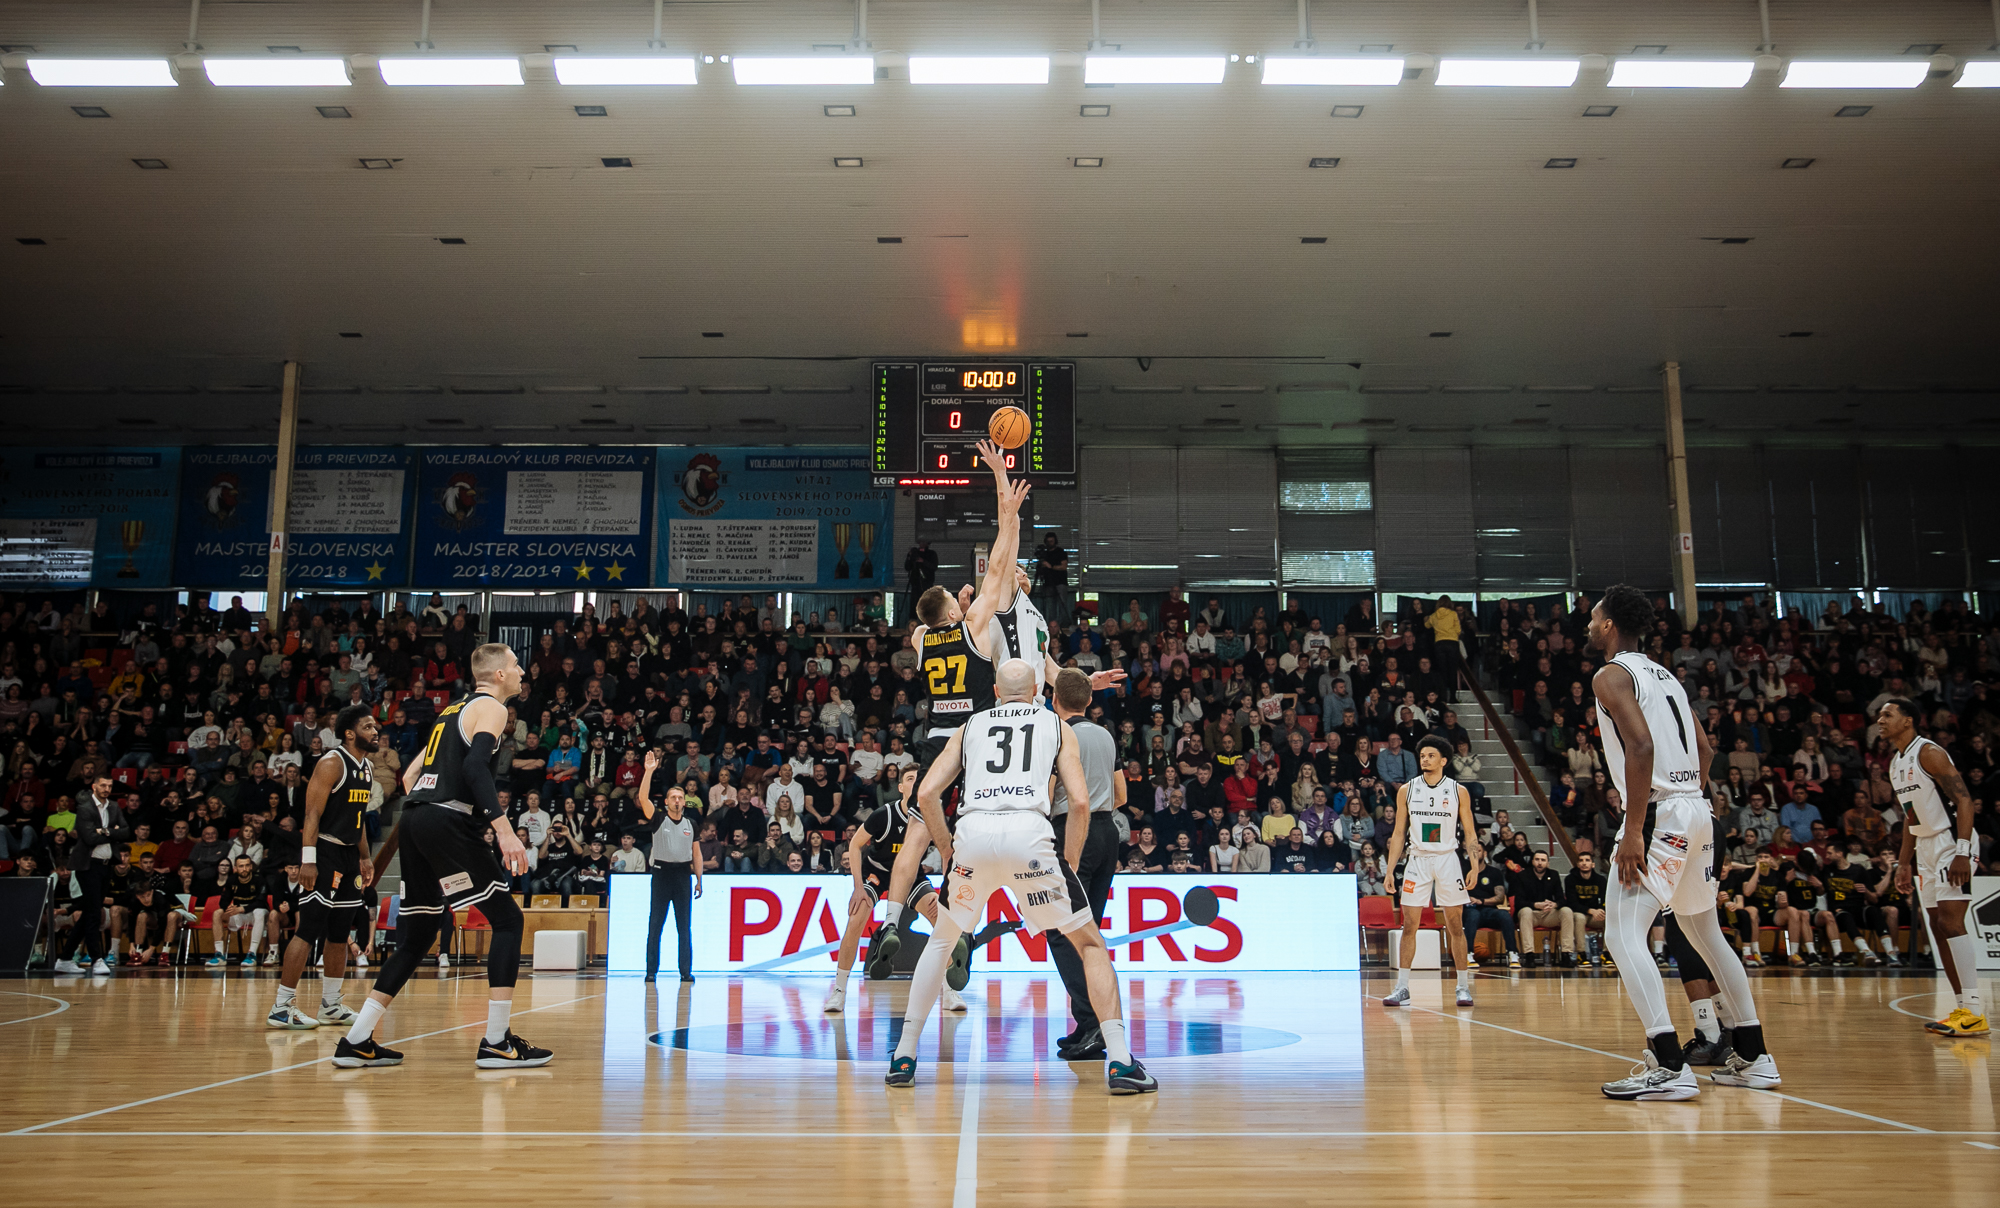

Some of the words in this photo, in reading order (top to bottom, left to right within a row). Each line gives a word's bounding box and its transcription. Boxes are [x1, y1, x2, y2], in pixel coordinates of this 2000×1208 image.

[931, 397, 962, 405] DOMÁCI
[950, 411, 961, 429] 0
[190, 454, 277, 464] VOLEJBALOV
[294, 454, 322, 464] LUB
[328, 454, 397, 464] PRIEVIDZA
[426, 450, 521, 464] VOLEJBALOVÝ
[525, 454, 559, 464] KLUB
[565, 454, 635, 464] PRIEVIDZA
[750, 457, 800, 468] VOLEJBALOVÝ
[801, 459, 820, 468] KLUB
[822, 459, 848, 468] OSMOS
[850, 459, 870, 468] PRIEV
[938, 454, 948, 469] 0
[972, 455, 978, 468] 1
[1006, 454, 1015, 469] 0
[874, 477, 895, 485] LGR
[272, 535, 281, 550] A
[1683, 536, 1690, 550] C
[194, 543, 268, 556] MAJSTE
[287, 543, 395, 557] SLOVENSKA
[434, 543, 519, 557] MAJSTER
[526, 543, 636, 557] SLOVENSKA
[239, 564, 348, 578] 20/2018
[452, 564, 562, 578] 2018/2019
[978, 559, 985, 573] B
[924, 654, 968, 694] 27
[936, 702, 969, 711] TOYOTA
[990, 708, 1040, 718] BELIKOV
[1666, 695, 1688, 754] 1
[424, 722, 446, 766] 0
[986, 724, 1034, 773] 31
[1670, 770, 1700, 783] SÜDW
[348, 789, 370, 803] INTE
[974, 785, 1035, 800] SÜDWEST
[1429, 797, 1434, 807] 3
[356, 810, 362, 829] 1
[1411, 810, 1452, 818] PRIEVIDZA
[1024, 867, 1055, 878] NICOLAUS
[1456, 878, 1465, 891] 3
[1027, 890, 1050, 906] BENY
